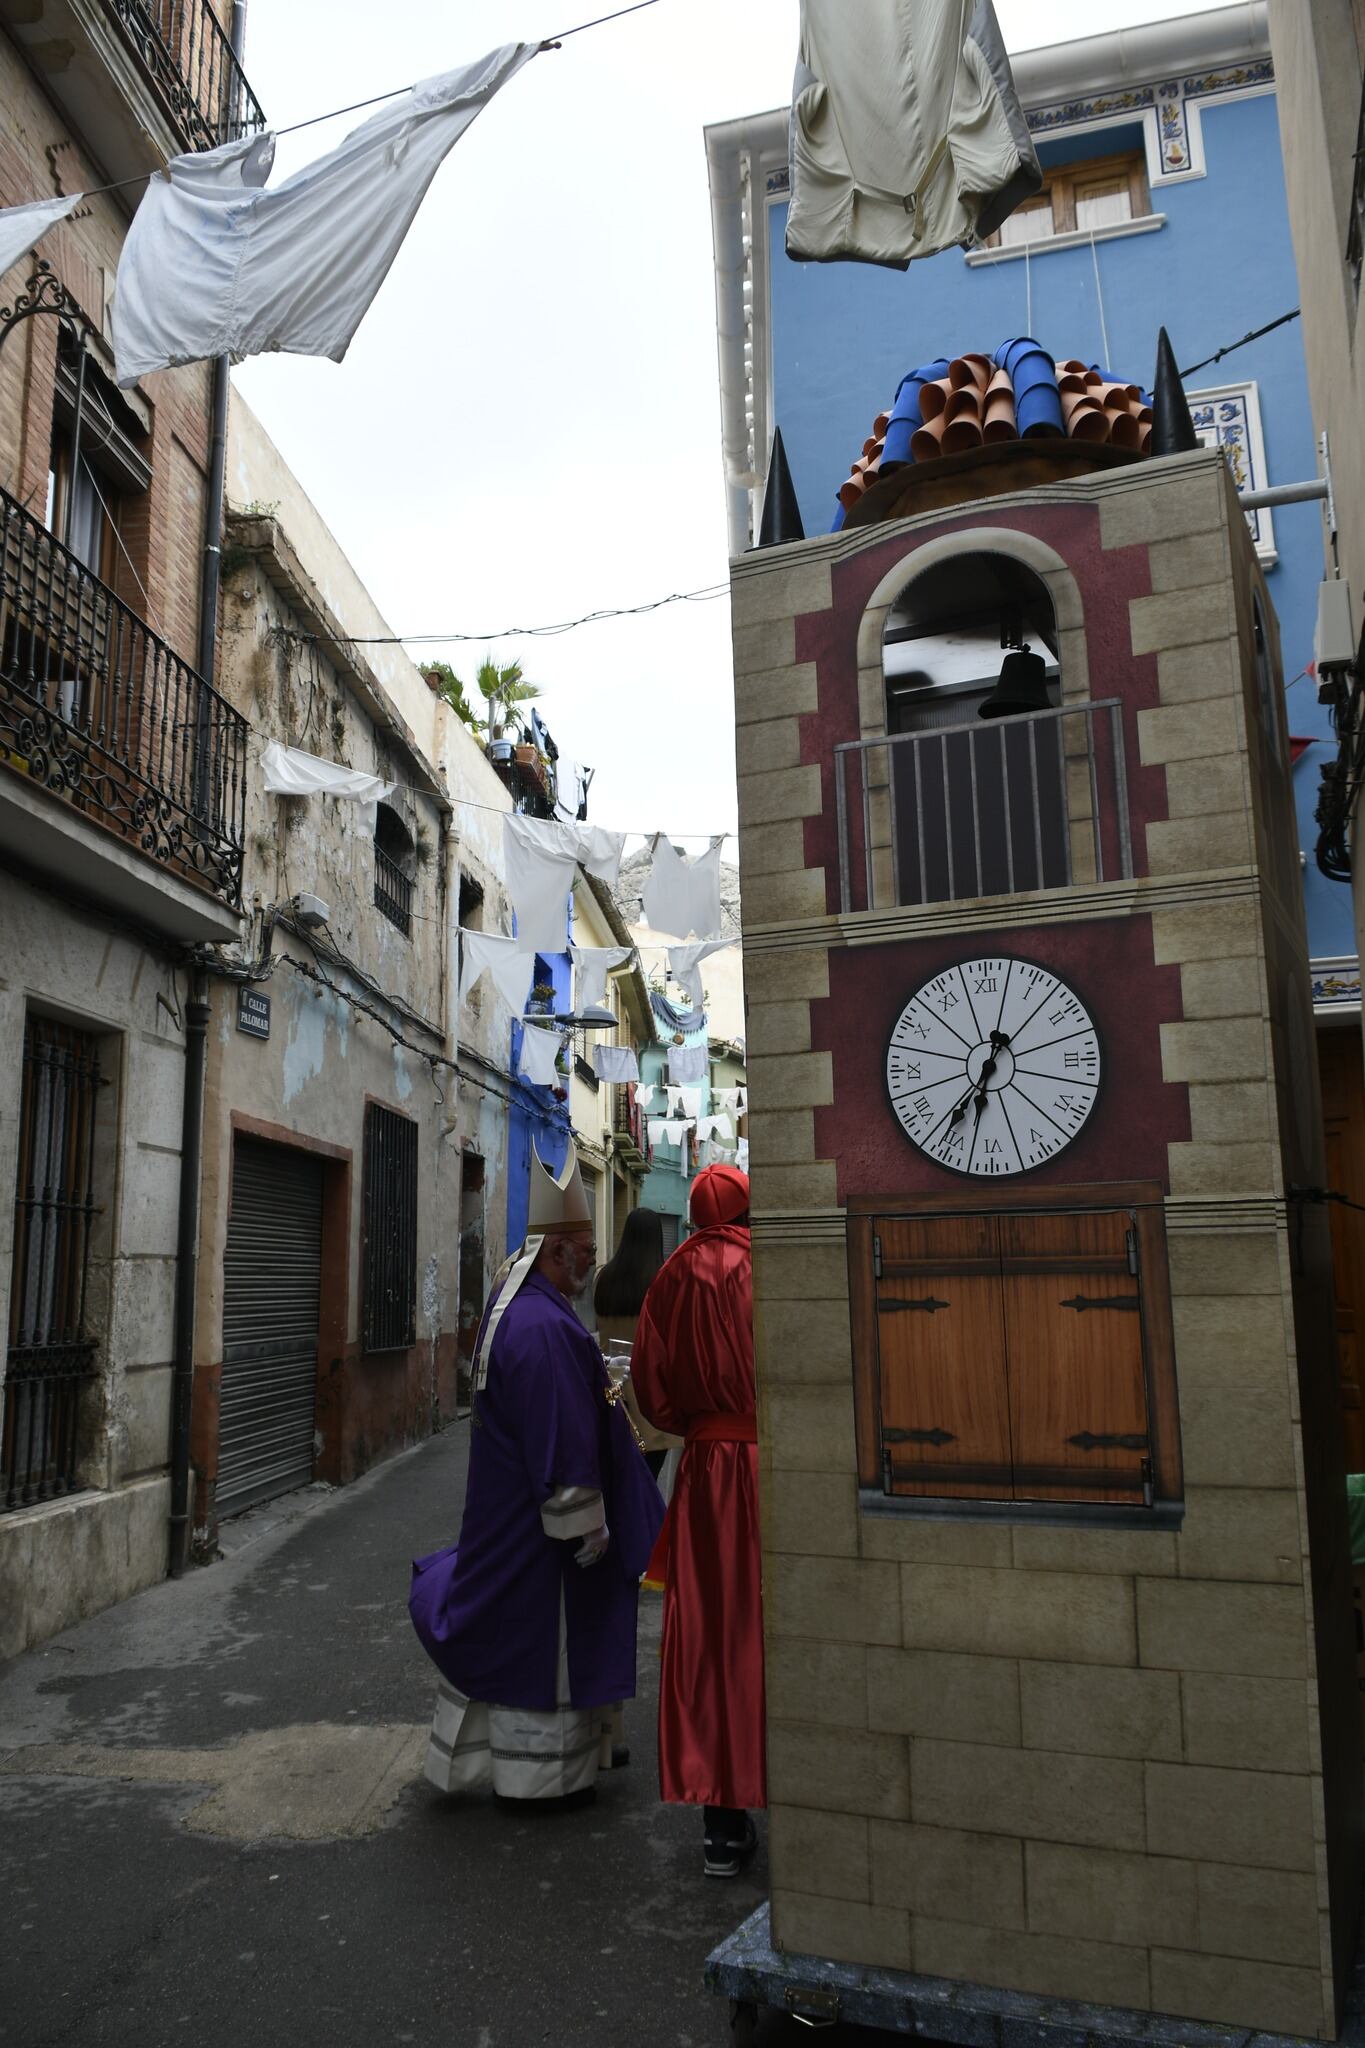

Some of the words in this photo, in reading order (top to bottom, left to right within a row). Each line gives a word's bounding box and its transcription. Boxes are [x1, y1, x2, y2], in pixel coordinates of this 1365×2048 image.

[974, 978, 998, 994] XII
[1023, 987, 1032, 1000] I
[249, 998, 267, 1014] CALLE
[937, 991, 960, 1012] XI
[241, 1012, 268, 1030] PALOMAR
[1048, 1010, 1065, 1026] II
[914, 1023, 931, 1039] X
[1064, 1051, 1079, 1067] III
[907, 1062, 921, 1080] IX
[913, 1096, 935, 1125] VIII
[942, 1129, 964, 1150] VII
[1030, 1128, 1043, 1144] V
[984, 1139, 1003, 1153] VI
